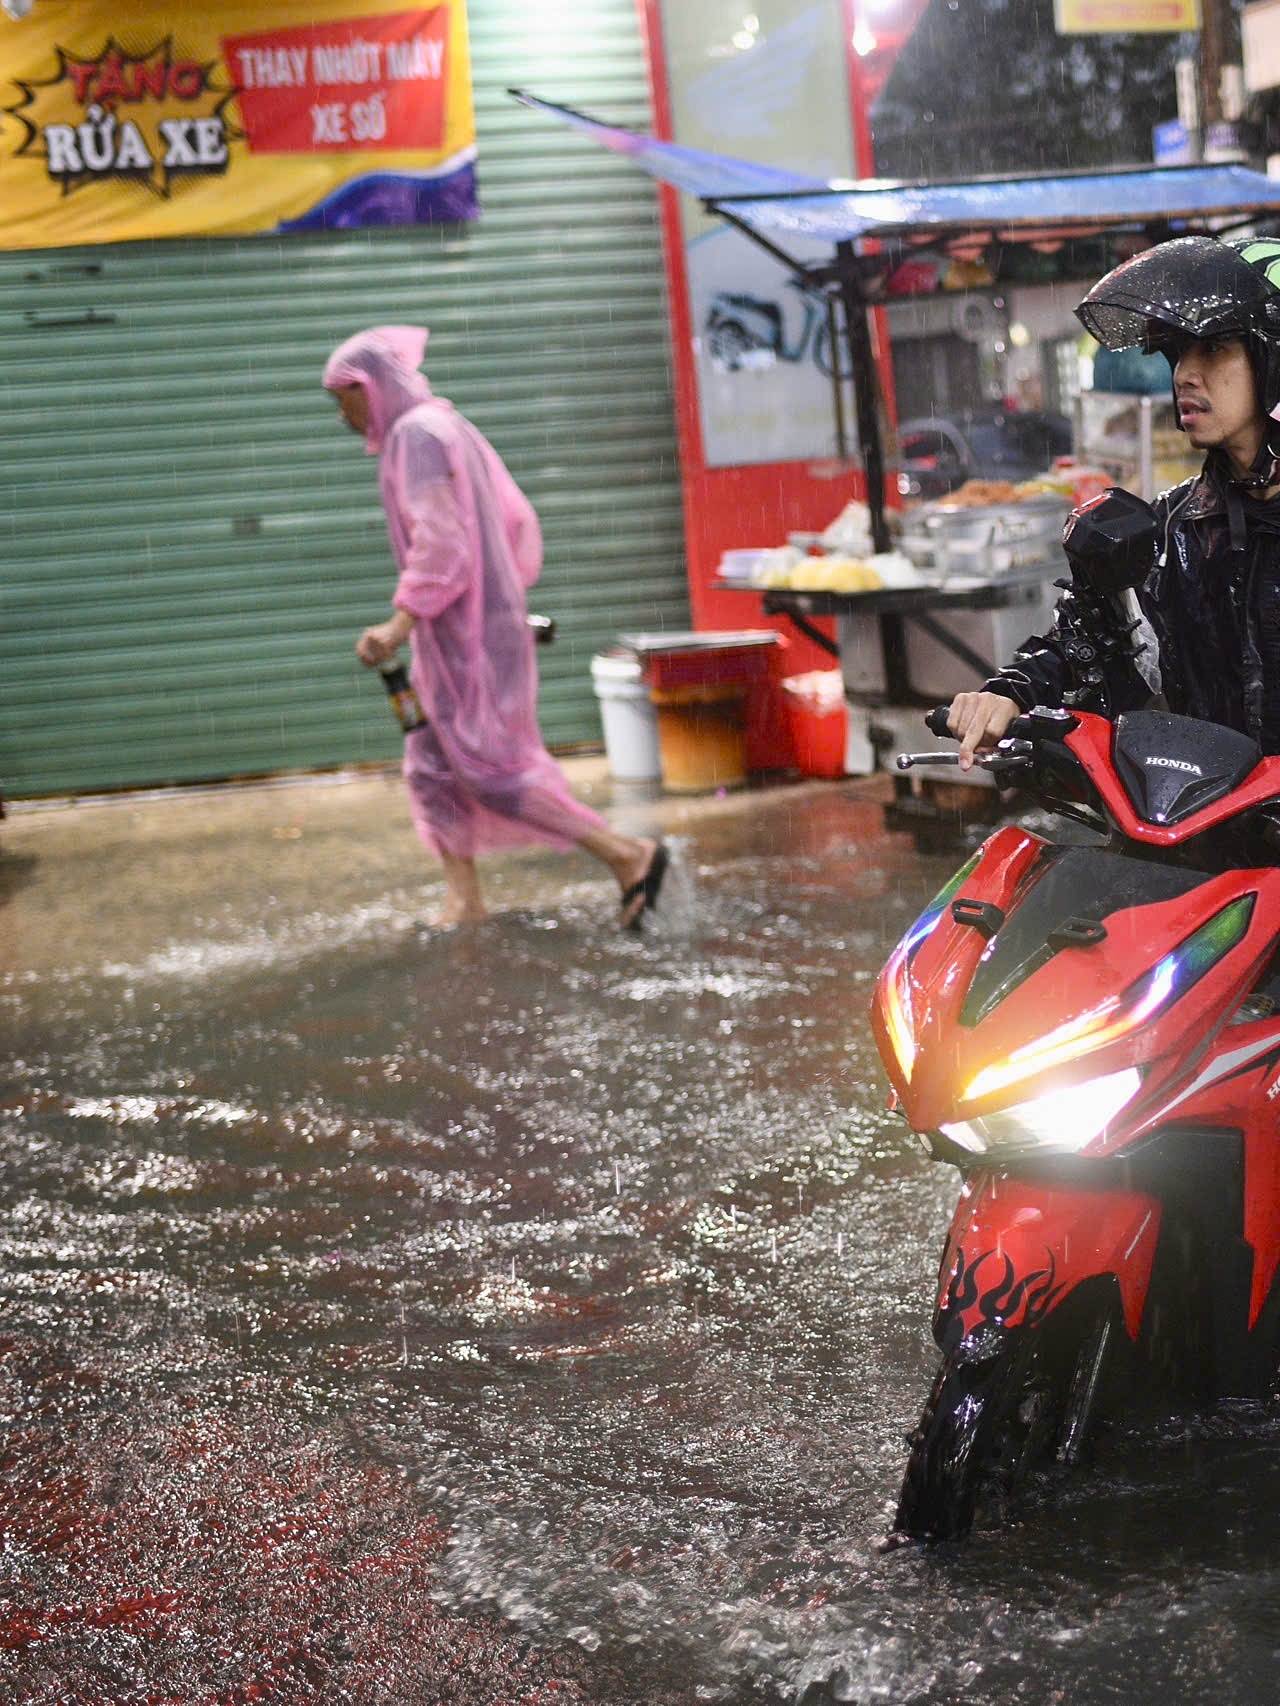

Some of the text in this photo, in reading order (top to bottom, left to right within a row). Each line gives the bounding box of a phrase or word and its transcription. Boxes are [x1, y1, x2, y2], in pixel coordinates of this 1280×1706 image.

[236, 47, 307, 88] THAY
[387, 33, 444, 80] MÁY
[44, 103, 229, 173] RỬA XE
[310, 90, 388, 144] XE SỐ
[1146, 757, 1203, 776] HONDA
